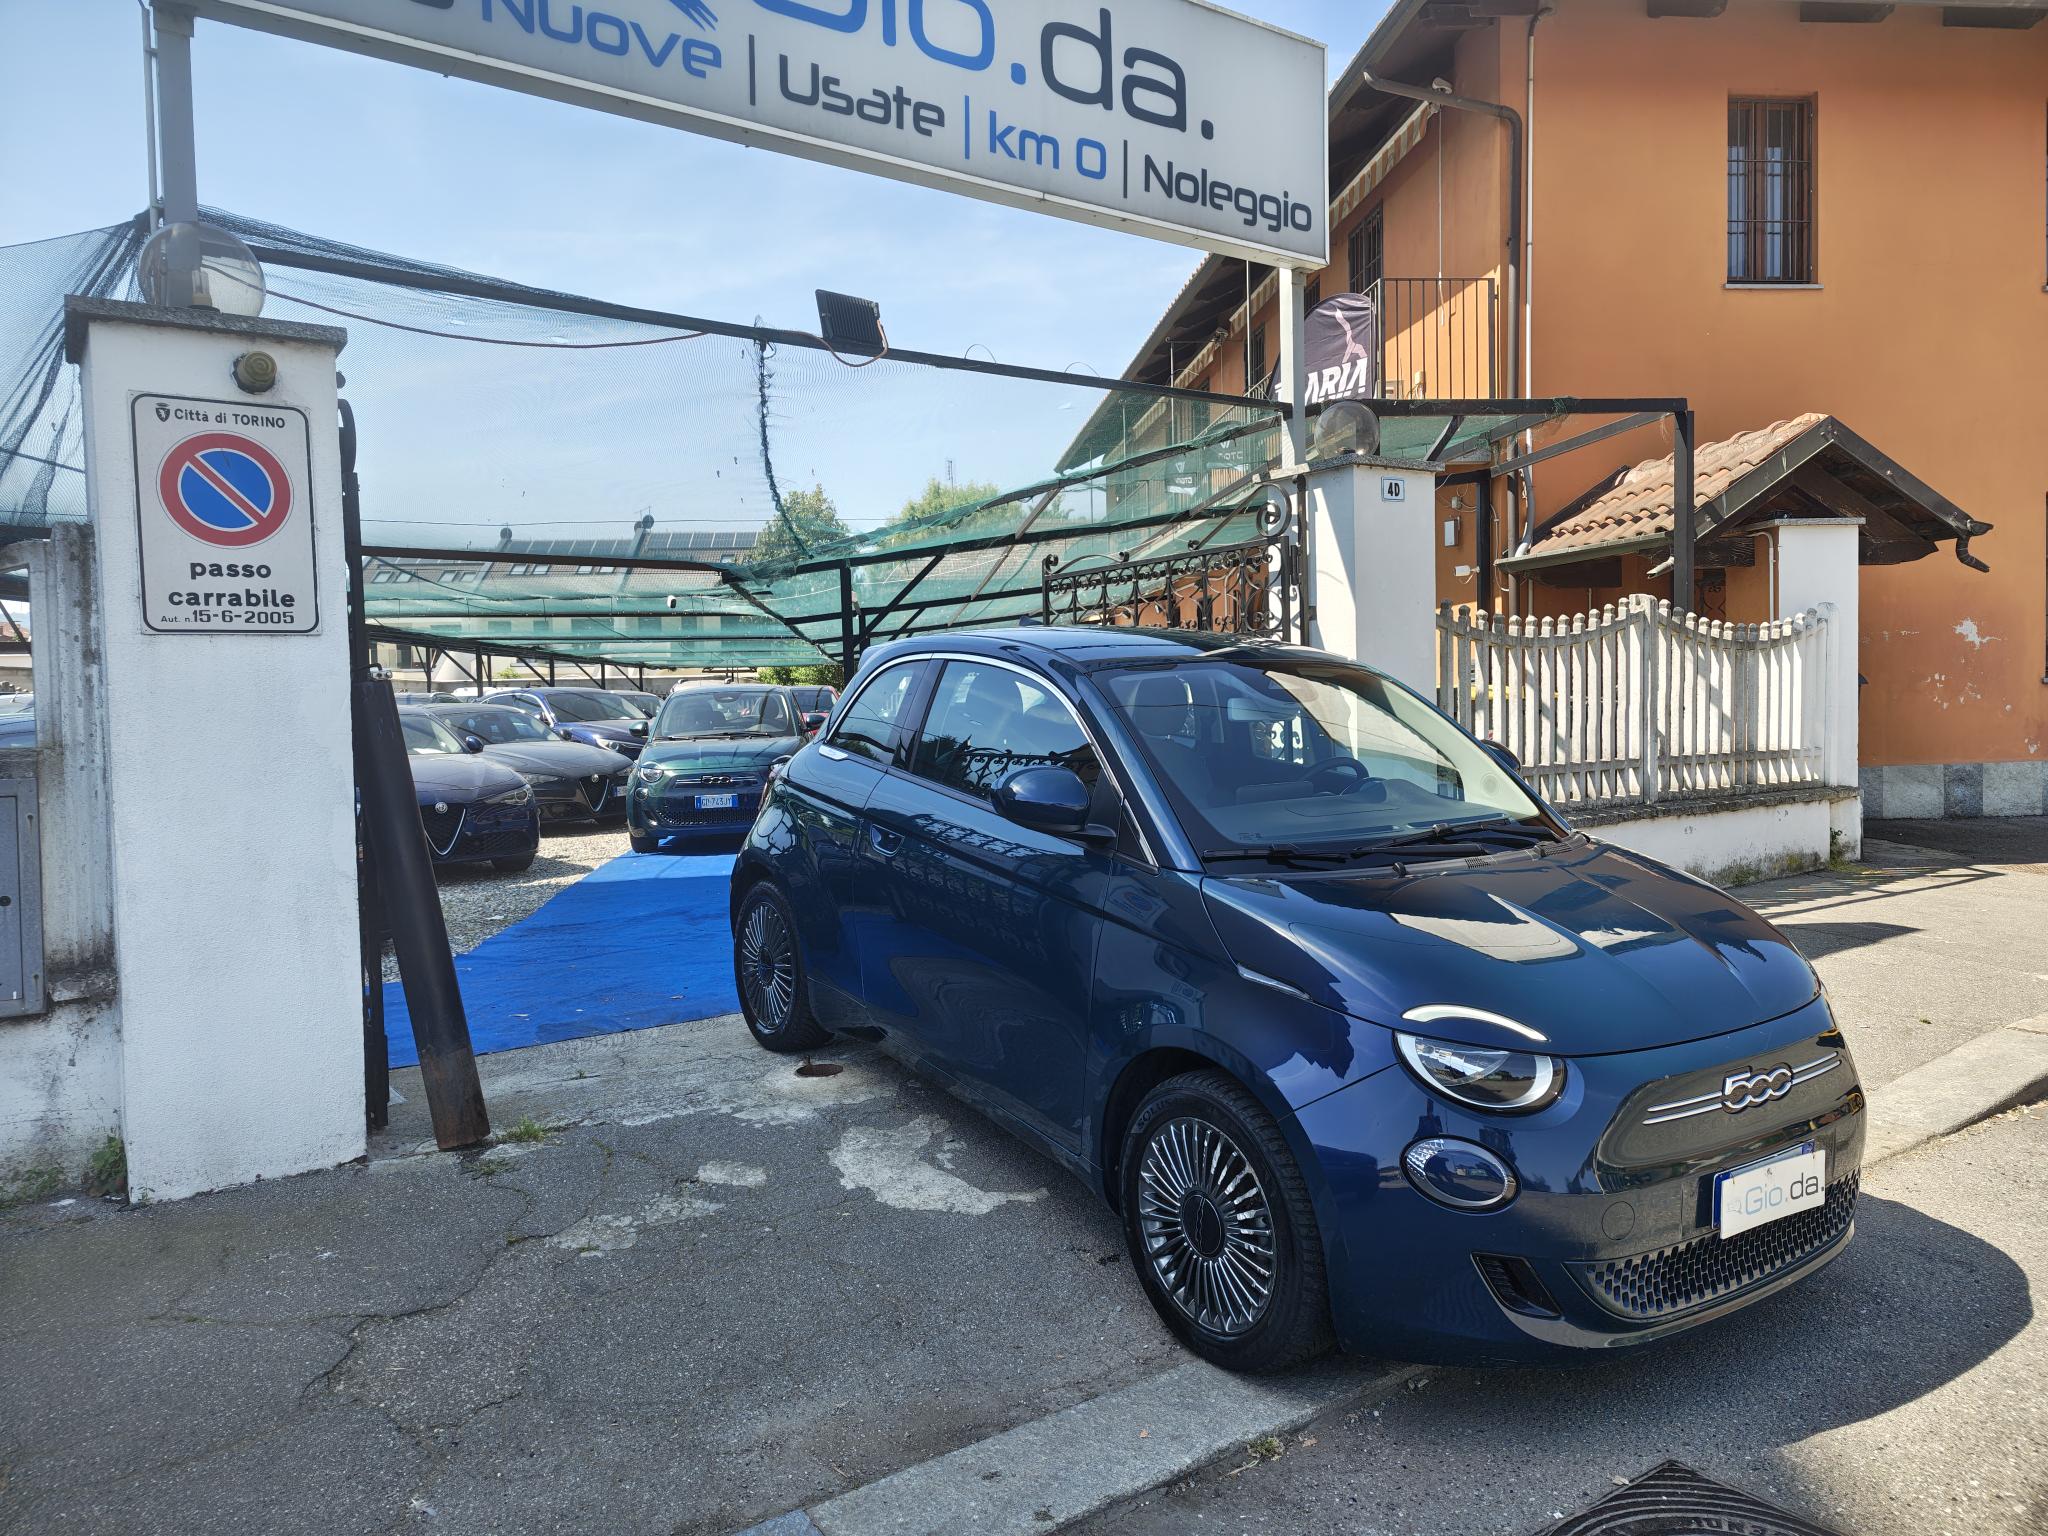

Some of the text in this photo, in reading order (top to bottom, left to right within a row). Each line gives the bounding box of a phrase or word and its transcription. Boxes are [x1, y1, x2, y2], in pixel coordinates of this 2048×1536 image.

[779, 53, 945, 137] Usate
[989, 110, 1060, 170] km
[1144, 154, 1312, 232] Noleggio
[174, 408, 286, 429] Città di TORINO
[1387, 481, 1401, 498] 4D
[190, 562, 271, 580] passo
[168, 589, 295, 608] carrabile
[160, 615, 182, 623] Aut.
[192, 609, 295, 624] 15-6-2005
[1721, 1068, 1793, 1114] 500
